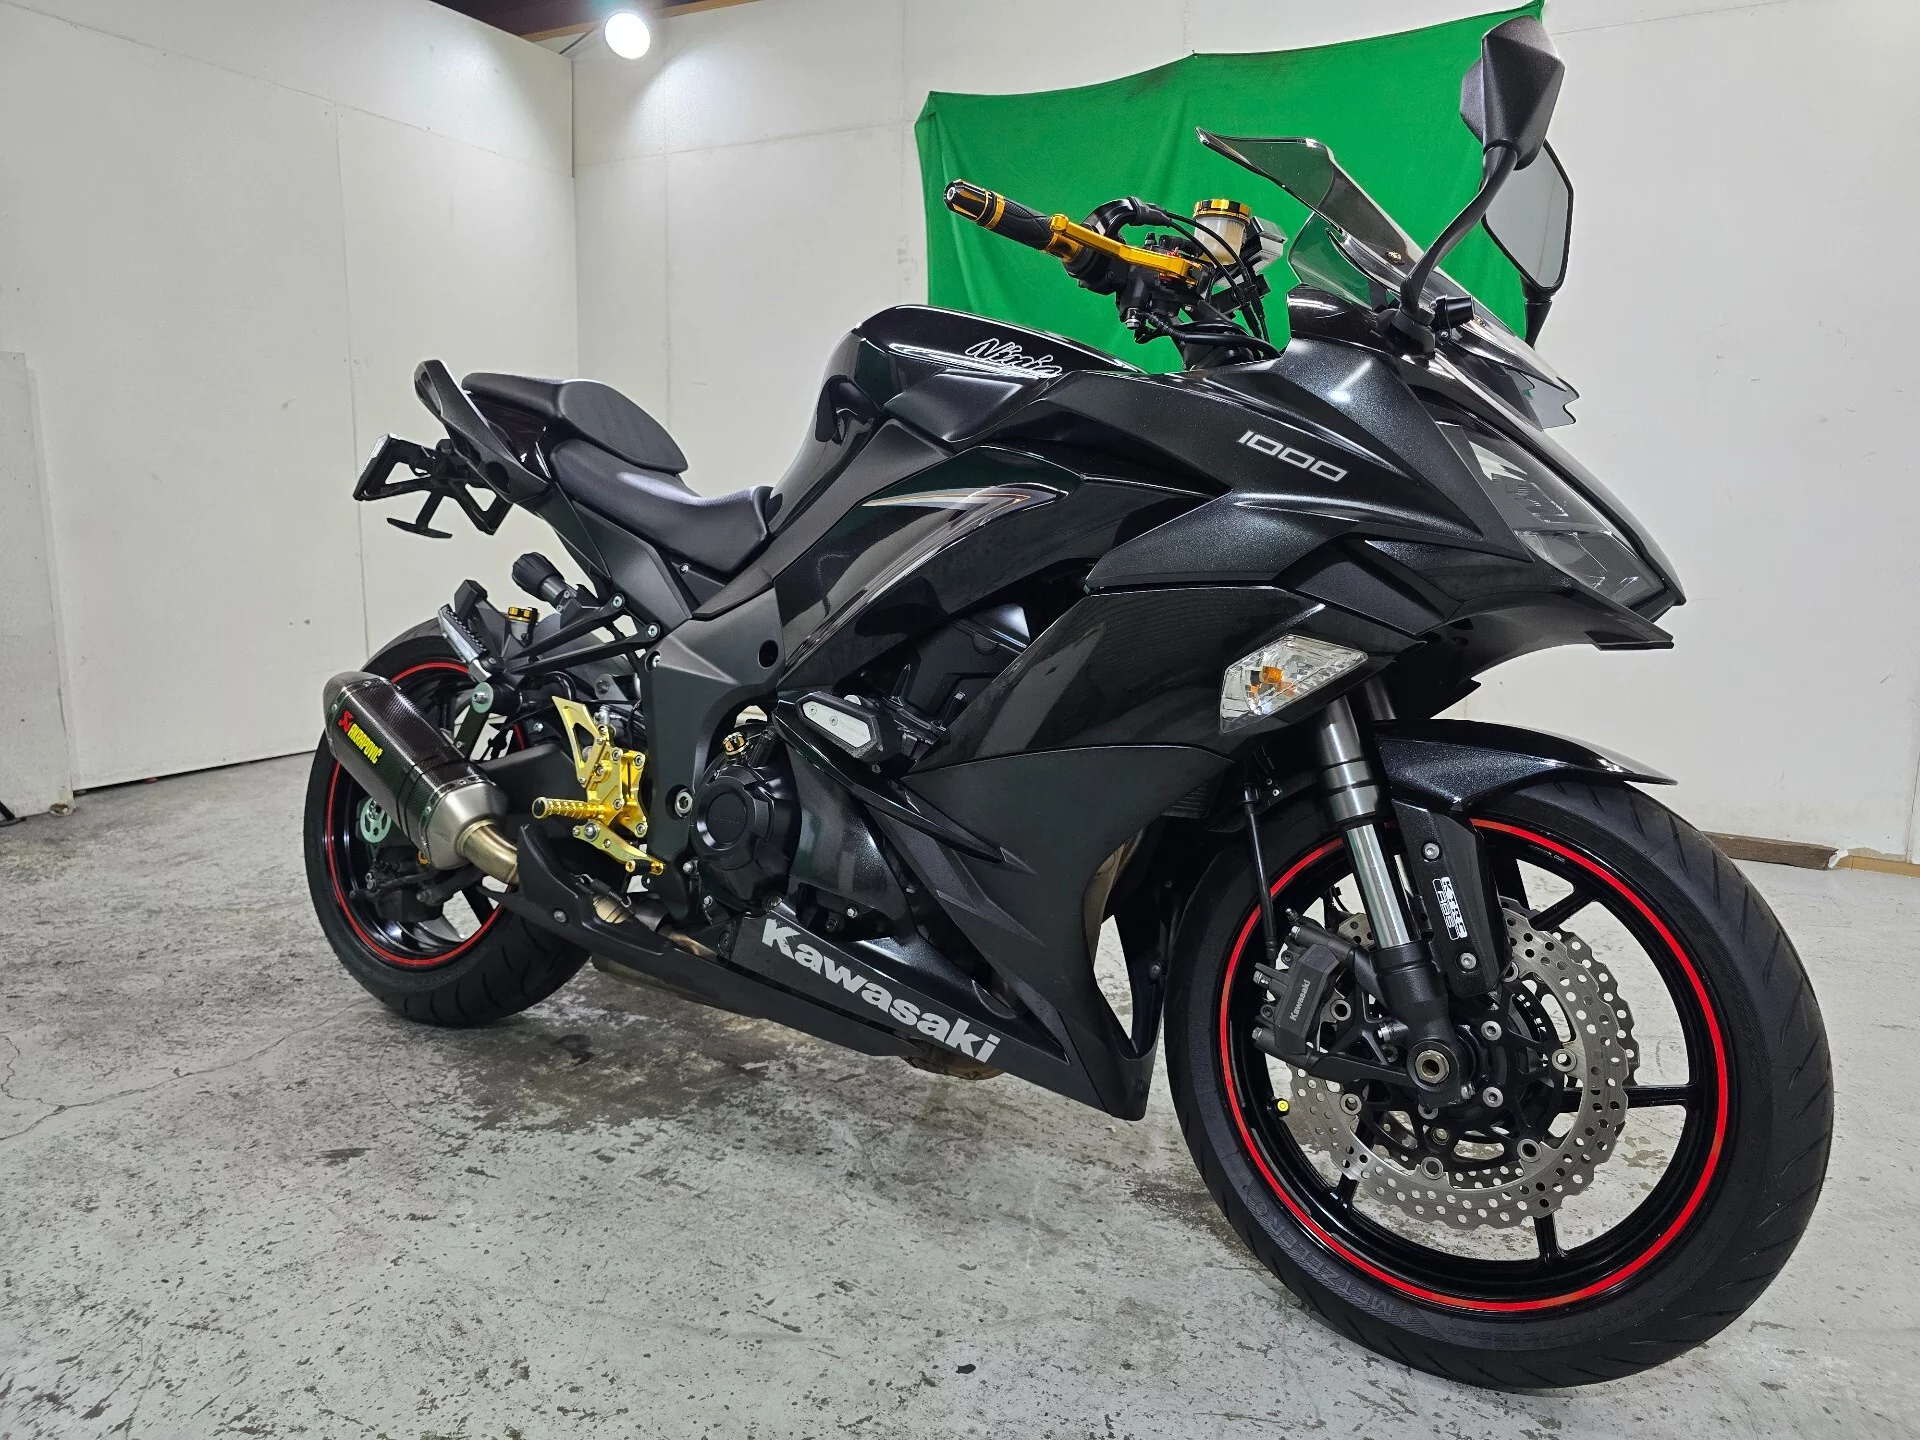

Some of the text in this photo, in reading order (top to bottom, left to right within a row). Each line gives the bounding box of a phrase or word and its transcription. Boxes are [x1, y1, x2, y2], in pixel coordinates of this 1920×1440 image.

[965, 338, 1063, 379] Ninja
[1237, 430, 1348, 482] 1000
[762, 918, 1001, 1063] Kawasaki
[1289, 979, 1311, 1021] Kawasaki
